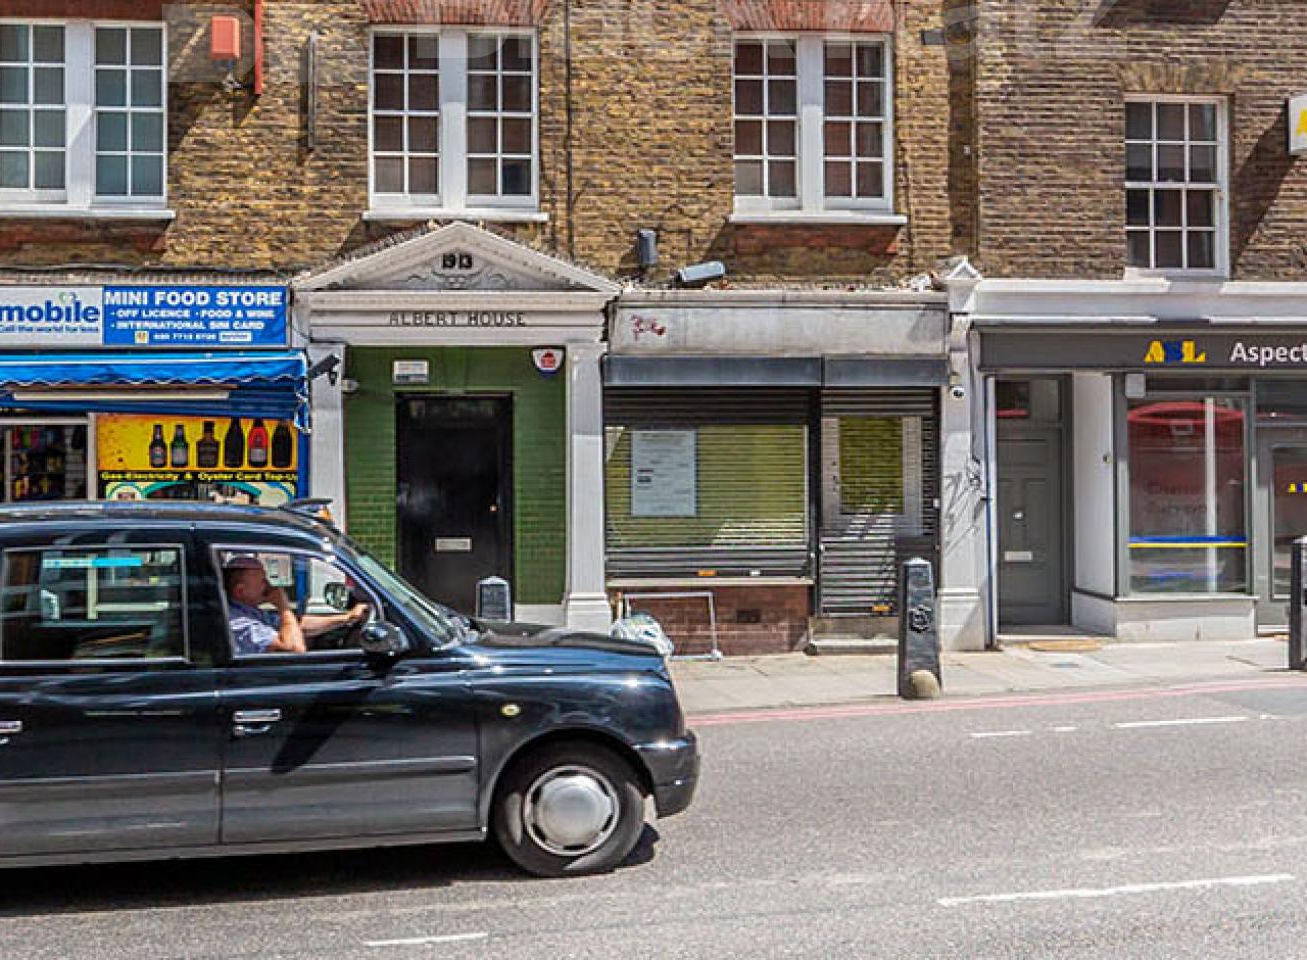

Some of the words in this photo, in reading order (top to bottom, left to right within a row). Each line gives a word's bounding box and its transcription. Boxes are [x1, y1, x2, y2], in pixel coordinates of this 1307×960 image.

[104, 291, 148, 305] MINI
[154, 291, 210, 306] FOOD
[215, 291, 283, 306] STORE
[116, 309, 139, 318] OFF
[143, 309, 191, 319] LICENCE
[200, 309, 232, 319] FOOD
[389, 311, 459, 327] ALBERT
[467, 312, 526, 327] HOUSE
[116, 321, 207, 330] INTERNATIONAL
